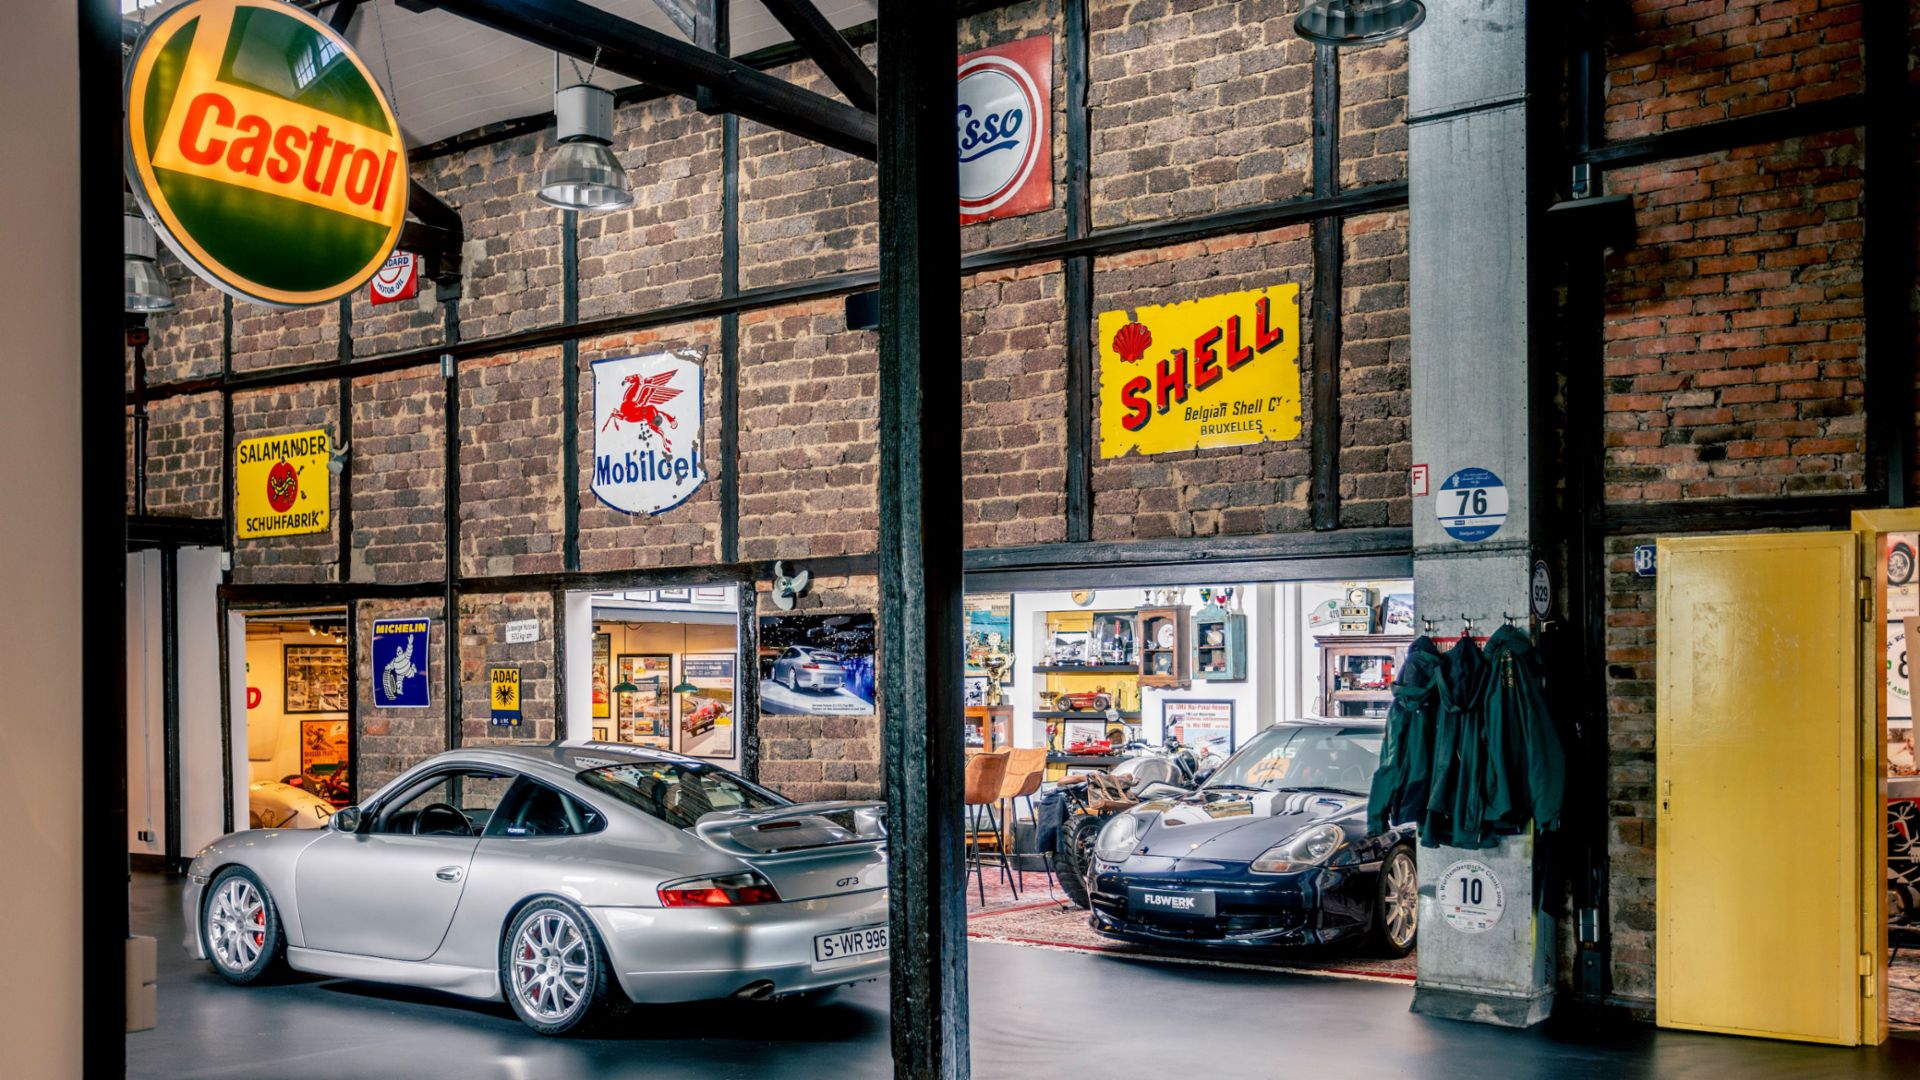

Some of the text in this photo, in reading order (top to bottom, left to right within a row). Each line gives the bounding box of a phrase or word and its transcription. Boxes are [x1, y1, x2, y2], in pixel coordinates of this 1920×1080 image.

[178, 92, 397, 212] Castrol
[376, 278, 404, 294] MOTOR OIL
[1121, 296, 1284, 432] SHELL
[1184, 403, 1227, 423] Belgian
[1232, 399, 1263, 416] Shell
[1200, 419, 1263, 436] BRUXELLES
[240, 435, 326, 464] SALAMANDER
[596, 449, 698, 487] Mobiloel
[1413, 470, 1423, 485] F
[1455, 488, 1487, 516] 76
[246, 511, 320, 532] SCHUHFABRIK
[1534, 584, 1548, 602] 929
[375, 623, 426, 634] MICHELIN
[492, 670, 518, 683] ADAC
[836, 876, 859, 888] GT3
[1460, 877, 1483, 905] 10
[1144, 893, 1195, 908] FL8WERK
[823, 929, 887, 957] S-WR 996
